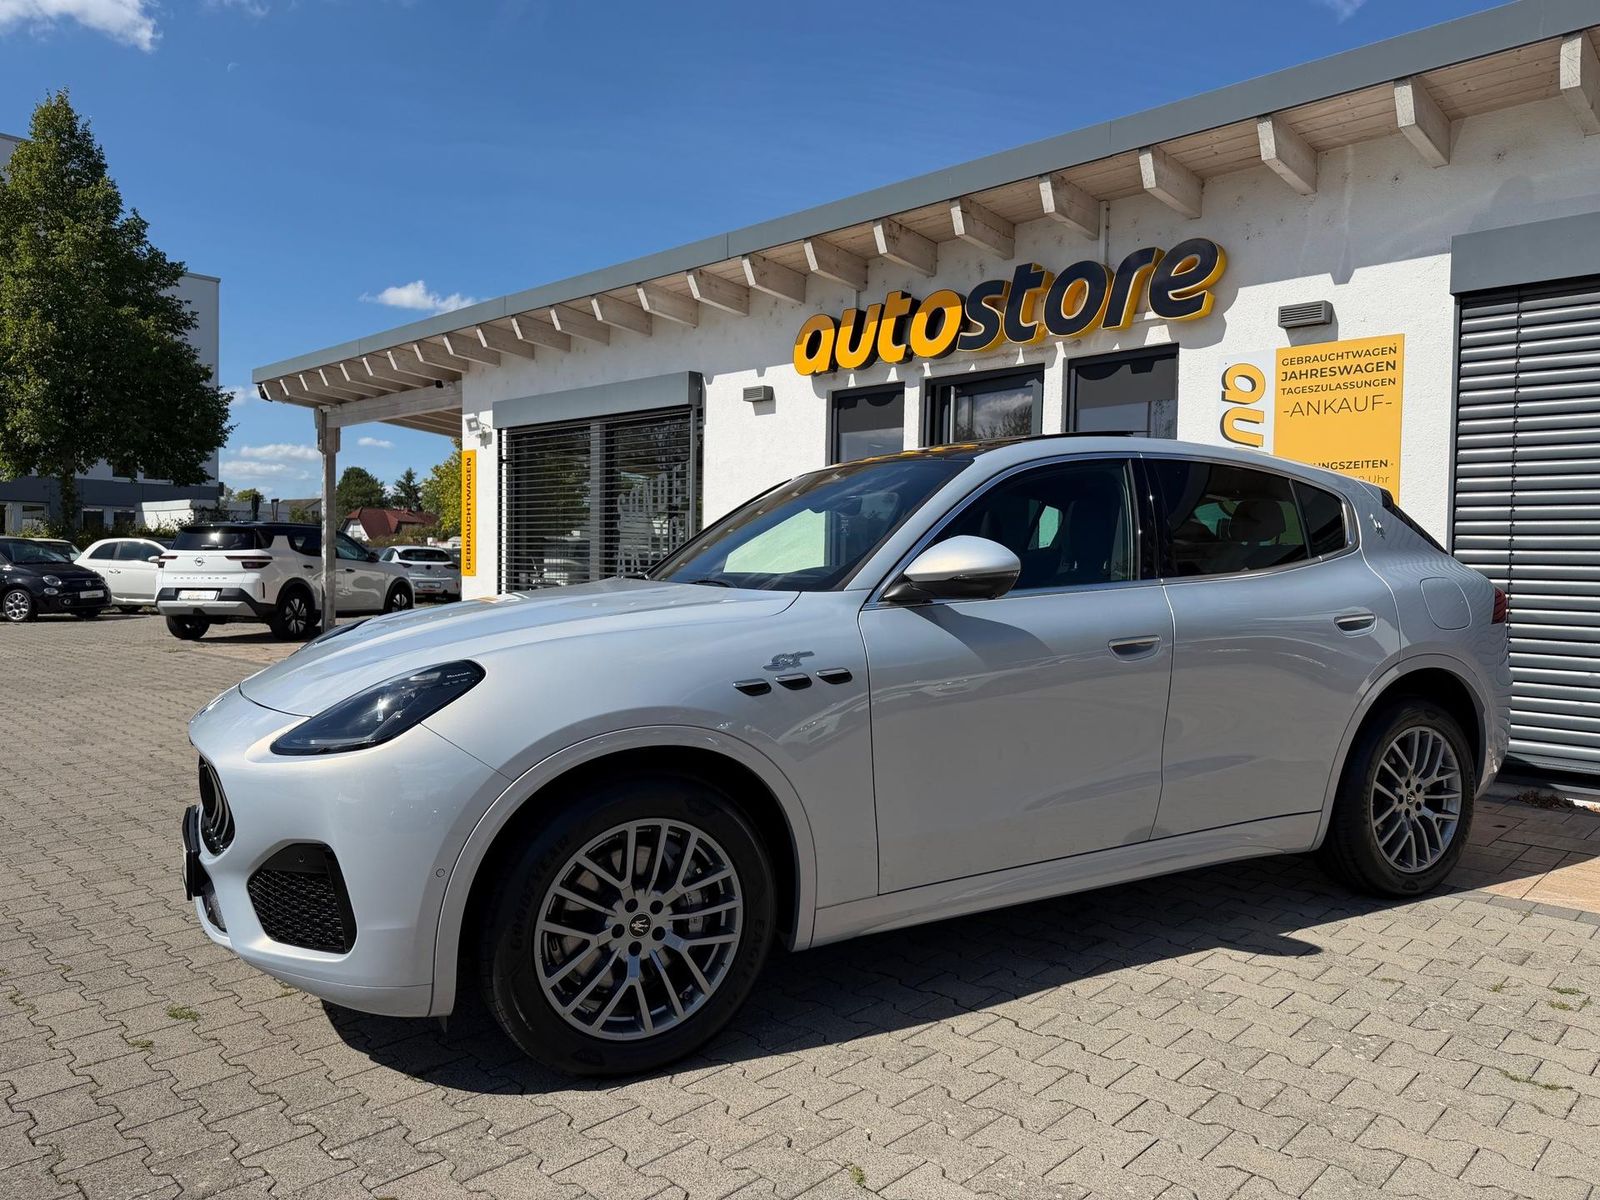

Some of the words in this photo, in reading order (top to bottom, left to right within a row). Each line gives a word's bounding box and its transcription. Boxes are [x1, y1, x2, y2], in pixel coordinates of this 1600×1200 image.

[793, 237, 1227, 376] autostore
[1281, 346, 1397, 366] GEBRAUCHTWAGEN
[1281, 360, 1397, 382] JAHRESWAGEN
[1281, 377, 1396, 396] TAGESZULASSUNGEN
[1220, 362, 1267, 450] au
